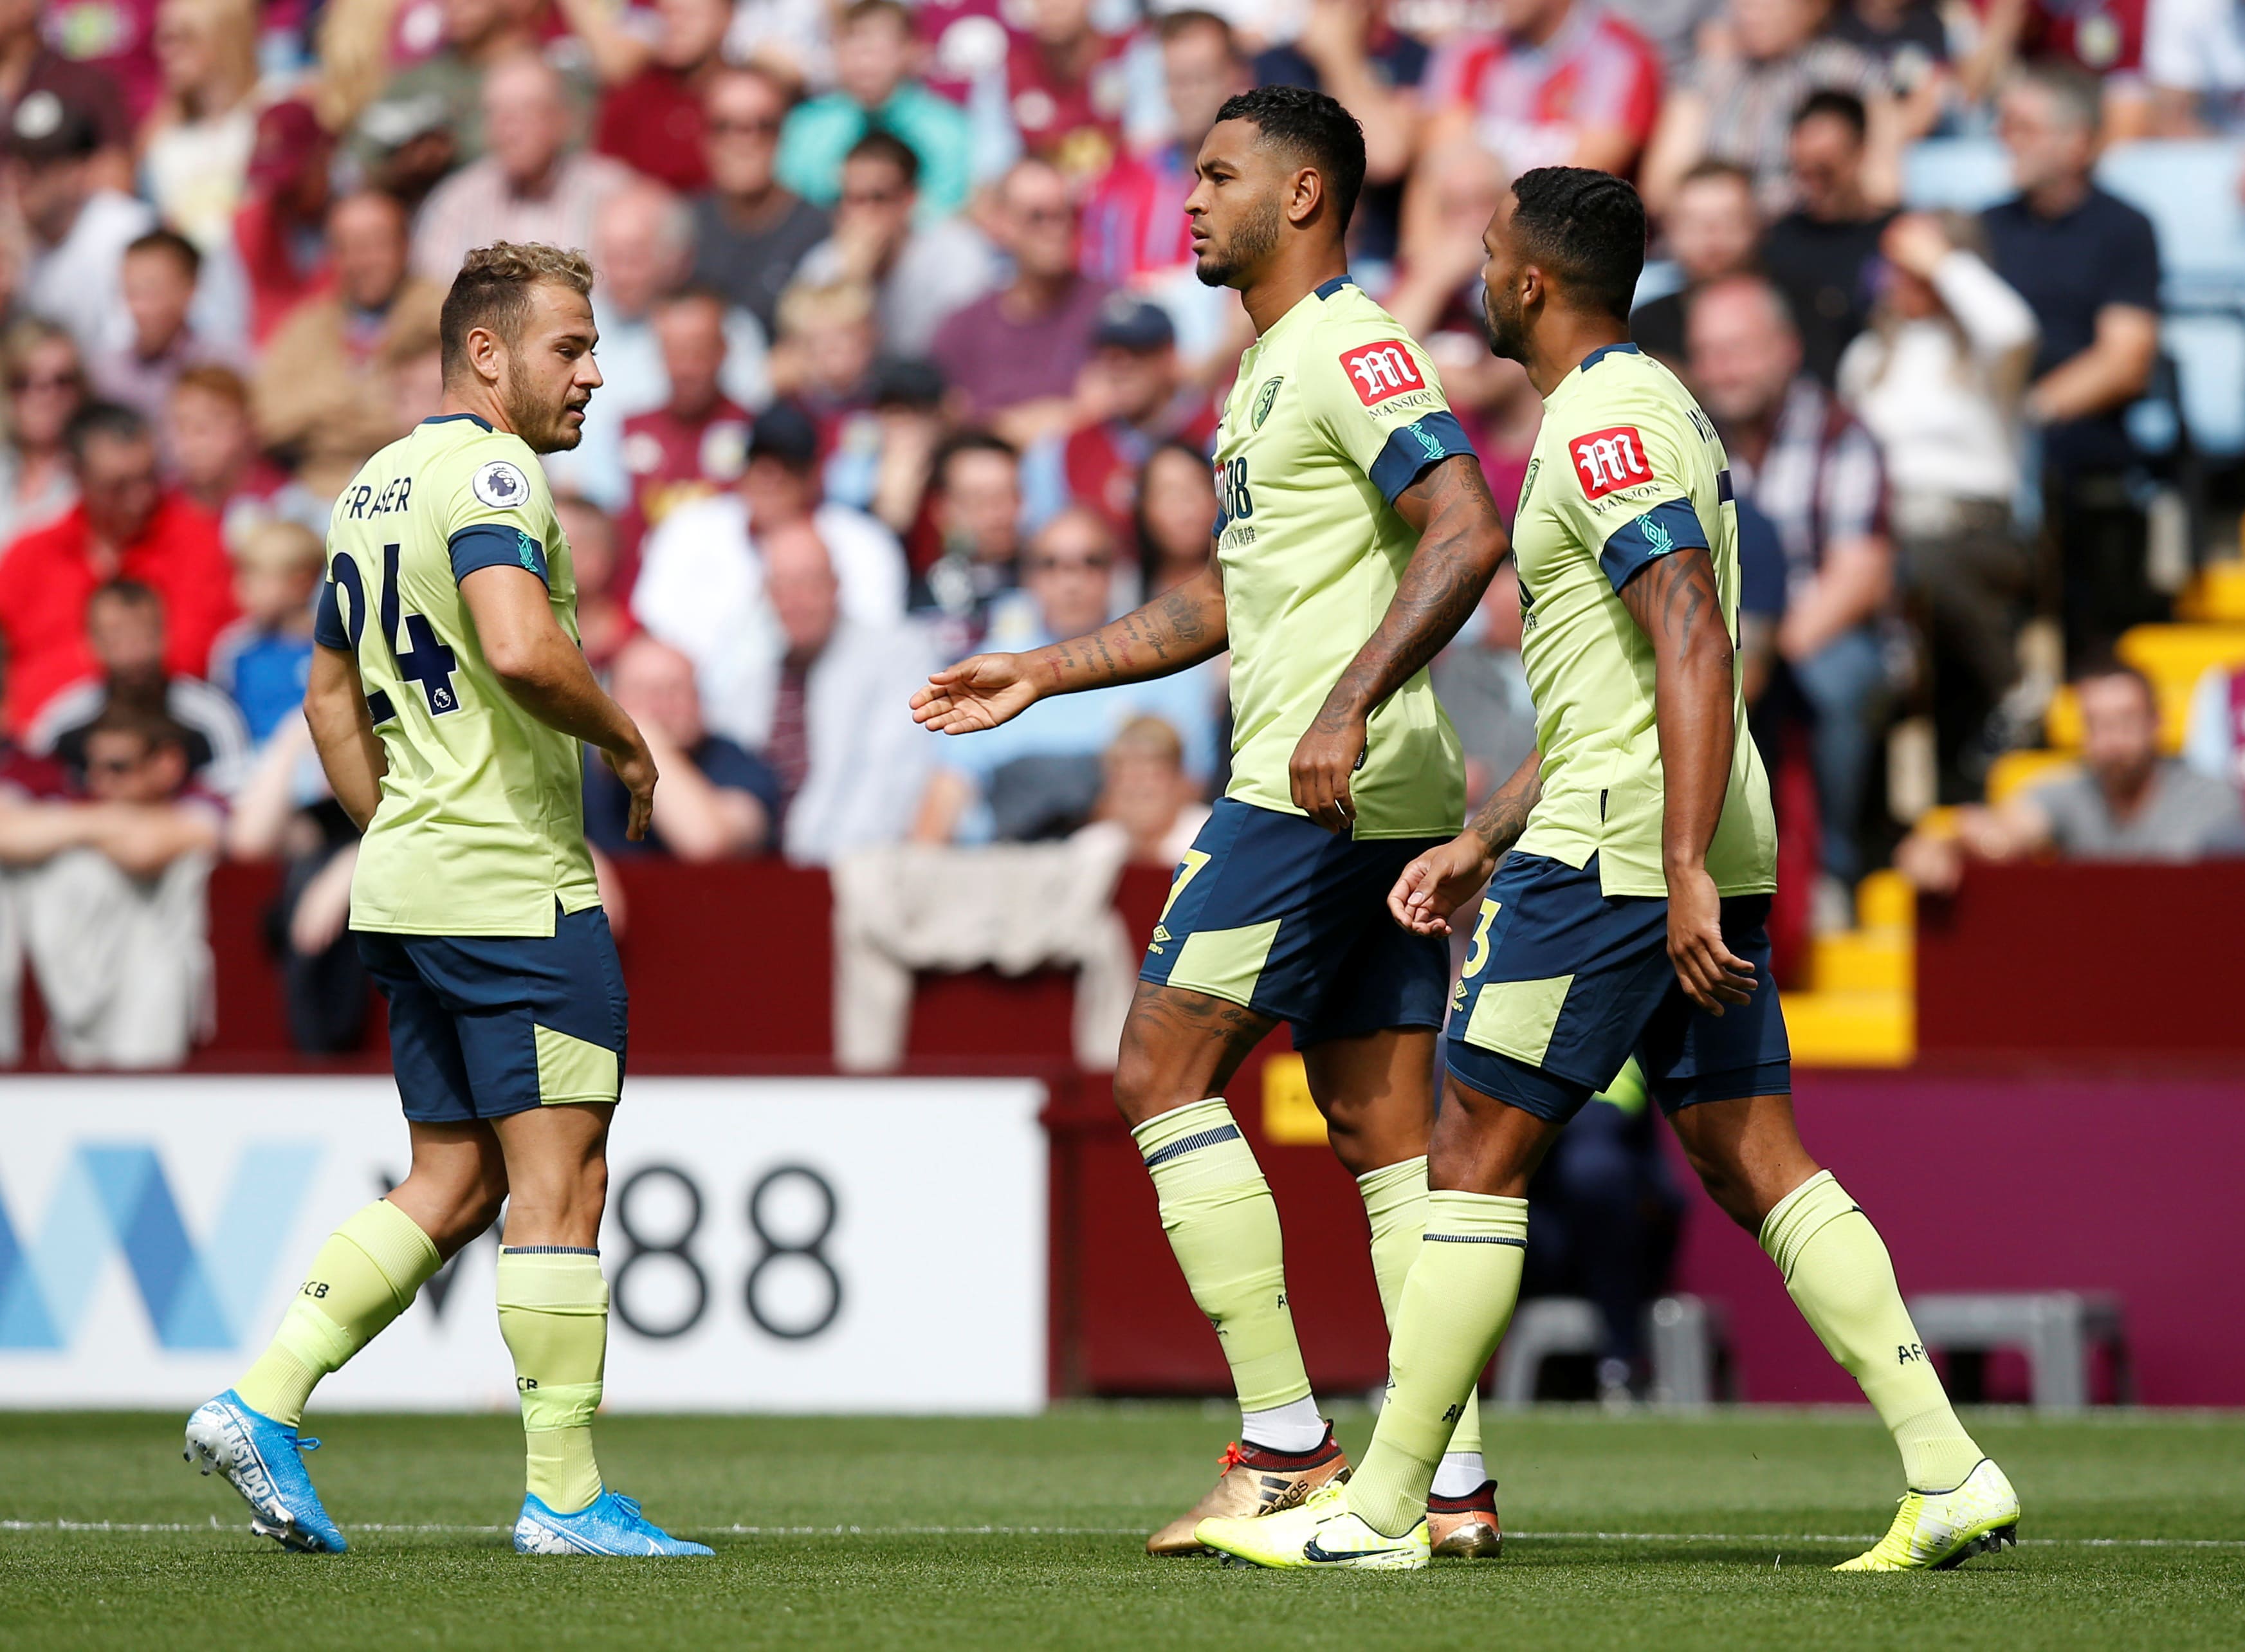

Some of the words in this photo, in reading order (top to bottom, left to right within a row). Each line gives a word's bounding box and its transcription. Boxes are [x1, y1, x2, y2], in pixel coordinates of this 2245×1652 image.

[1368, 392, 1433, 421] MANSION
[1592, 483, 1662, 516] MANSION
[1159, 849, 1212, 923] 7
[1462, 897, 1503, 978] 3
[242, 1465, 270, 1496] DO
